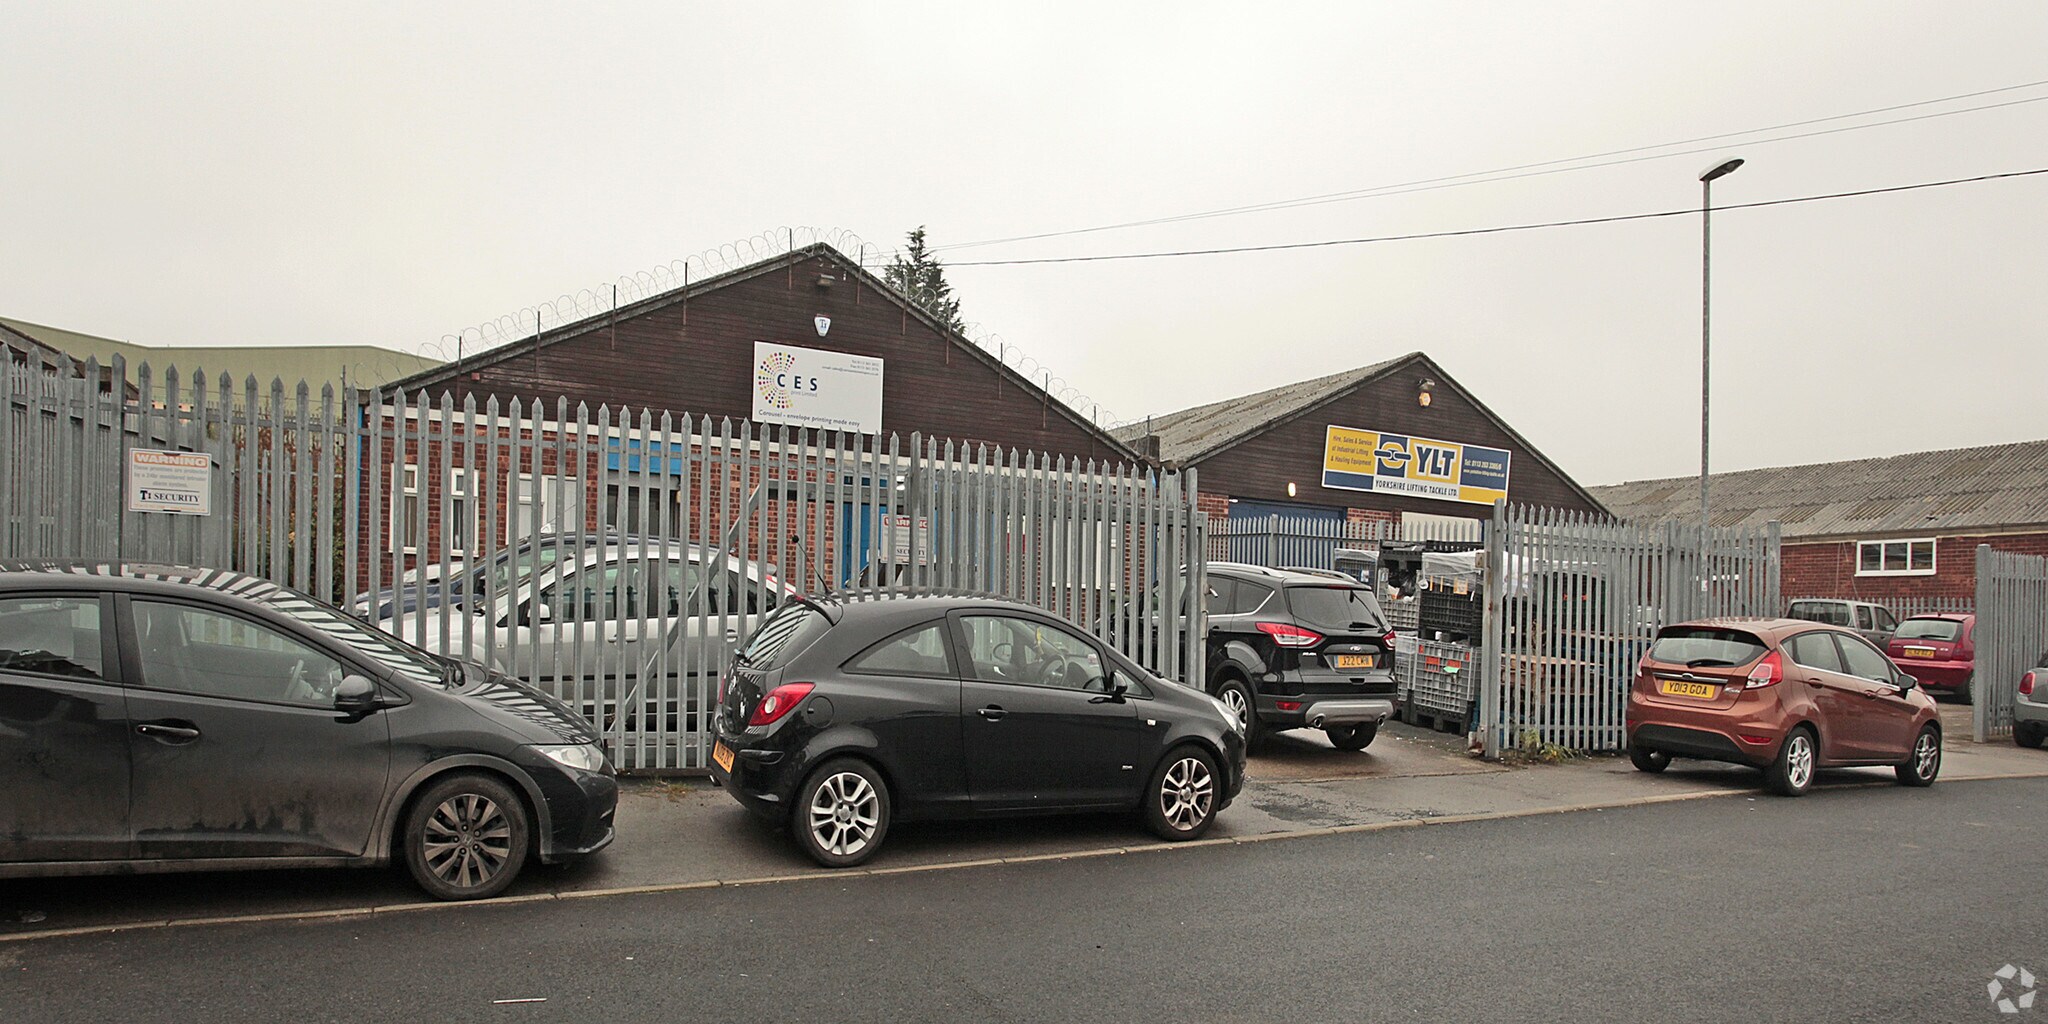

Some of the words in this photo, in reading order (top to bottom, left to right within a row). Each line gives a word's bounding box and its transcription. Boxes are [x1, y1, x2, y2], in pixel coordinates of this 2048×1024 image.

[758, 408, 783, 418] Carousel
[786, 412, 811, 421] envelope
[811, 415, 832, 424] printing
[1343, 436, 1354, 444] Sales
[1358, 438, 1373, 446] Service
[1337, 445, 1355, 454] Industrial
[1356, 448, 1369, 457] Lifting
[136, 453, 206, 467] WARNING
[1335, 456, 1350, 464] Hauling
[1351, 458, 1372, 466] Equipment
[1415, 445, 1456, 477] YLT
[1375, 479, 1406, 491] YORKSHIRE
[1406, 483, 1428, 493] LIFTING
[1428, 486, 1447, 496] TACKLE
[1447, 488, 1458, 497] LTD.
[154, 492, 200, 502] SECURITY
[1668, 682, 1688, 694] YD13
[1689, 684, 1708, 695] GOA
